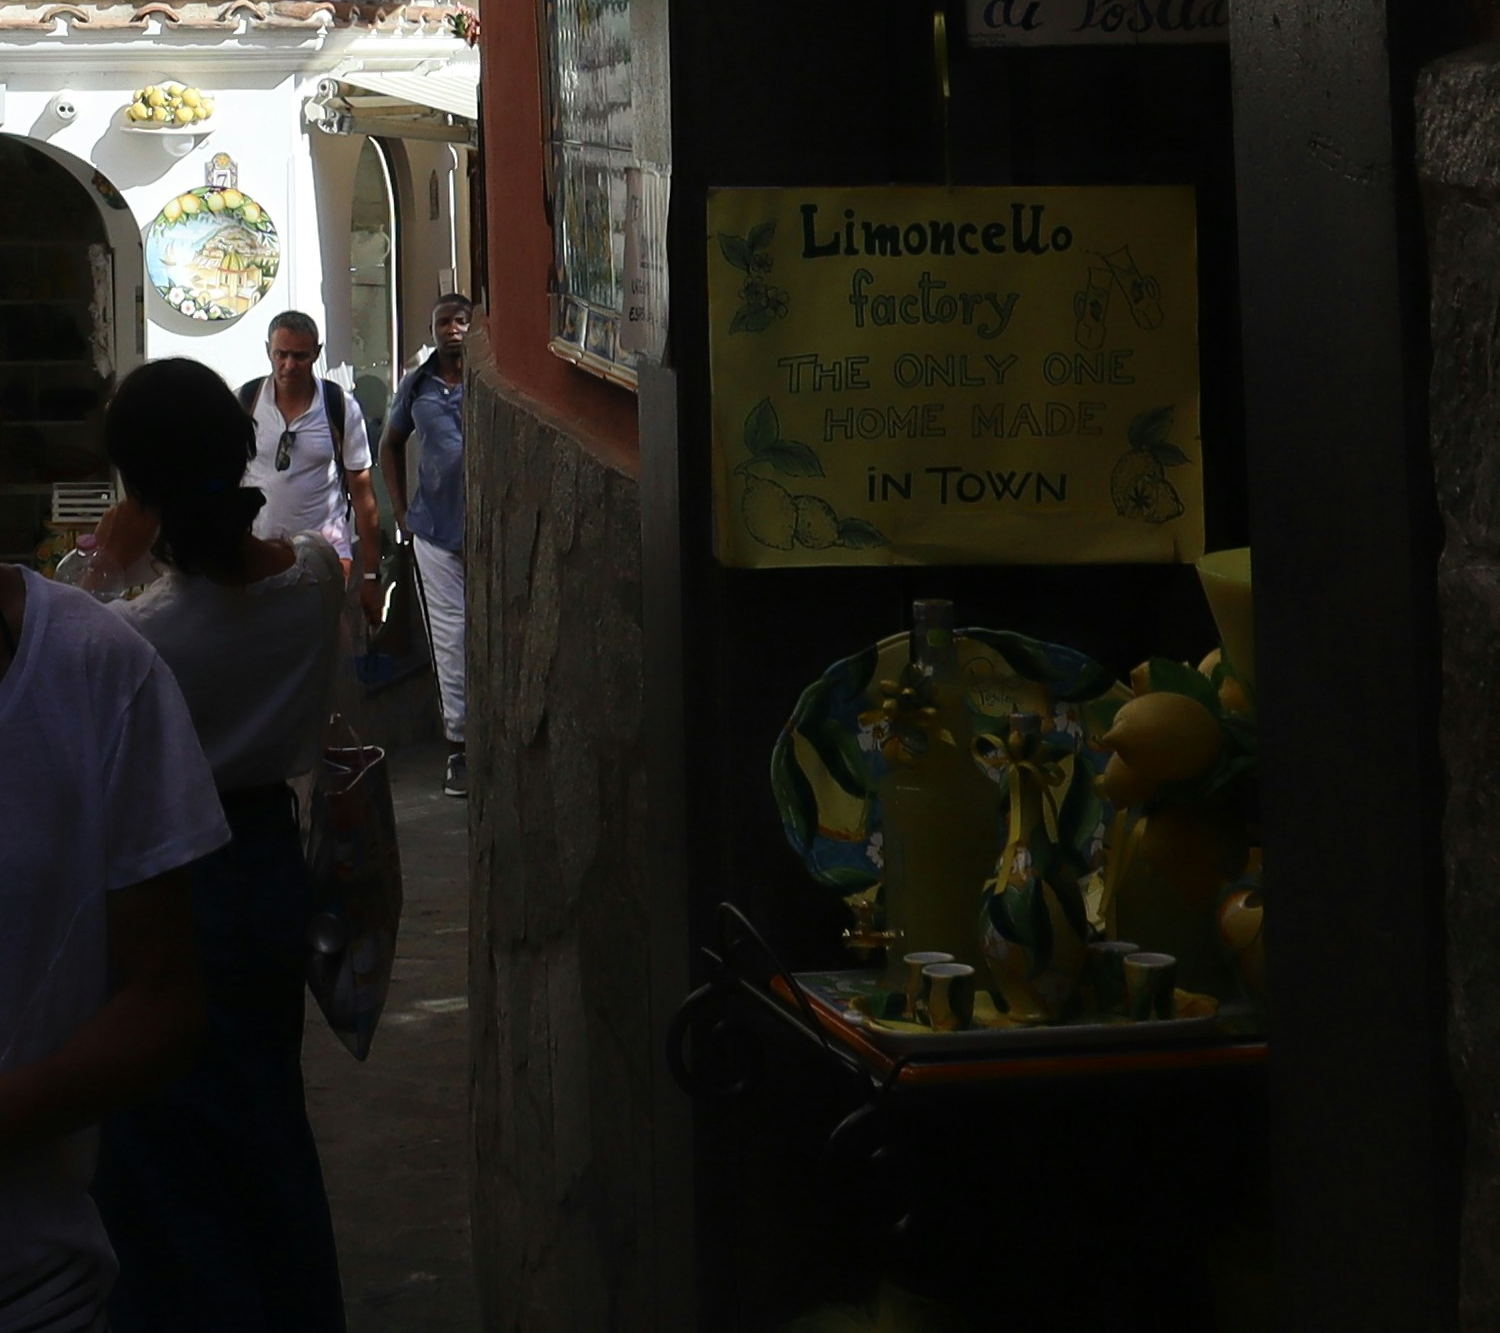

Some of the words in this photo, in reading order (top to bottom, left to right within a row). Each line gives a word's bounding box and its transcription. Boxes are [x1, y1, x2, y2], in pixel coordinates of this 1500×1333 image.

[800, 203, 1073, 259] Limoncello
[849, 268, 1020, 340] factory
[777, 354, 871, 394] THE
[894, 354, 1019, 388] ONLY
[1042, 349, 1136, 385] ONE
[823, 403, 946, 442] HOME
[972, 401, 1107, 438] MADE
